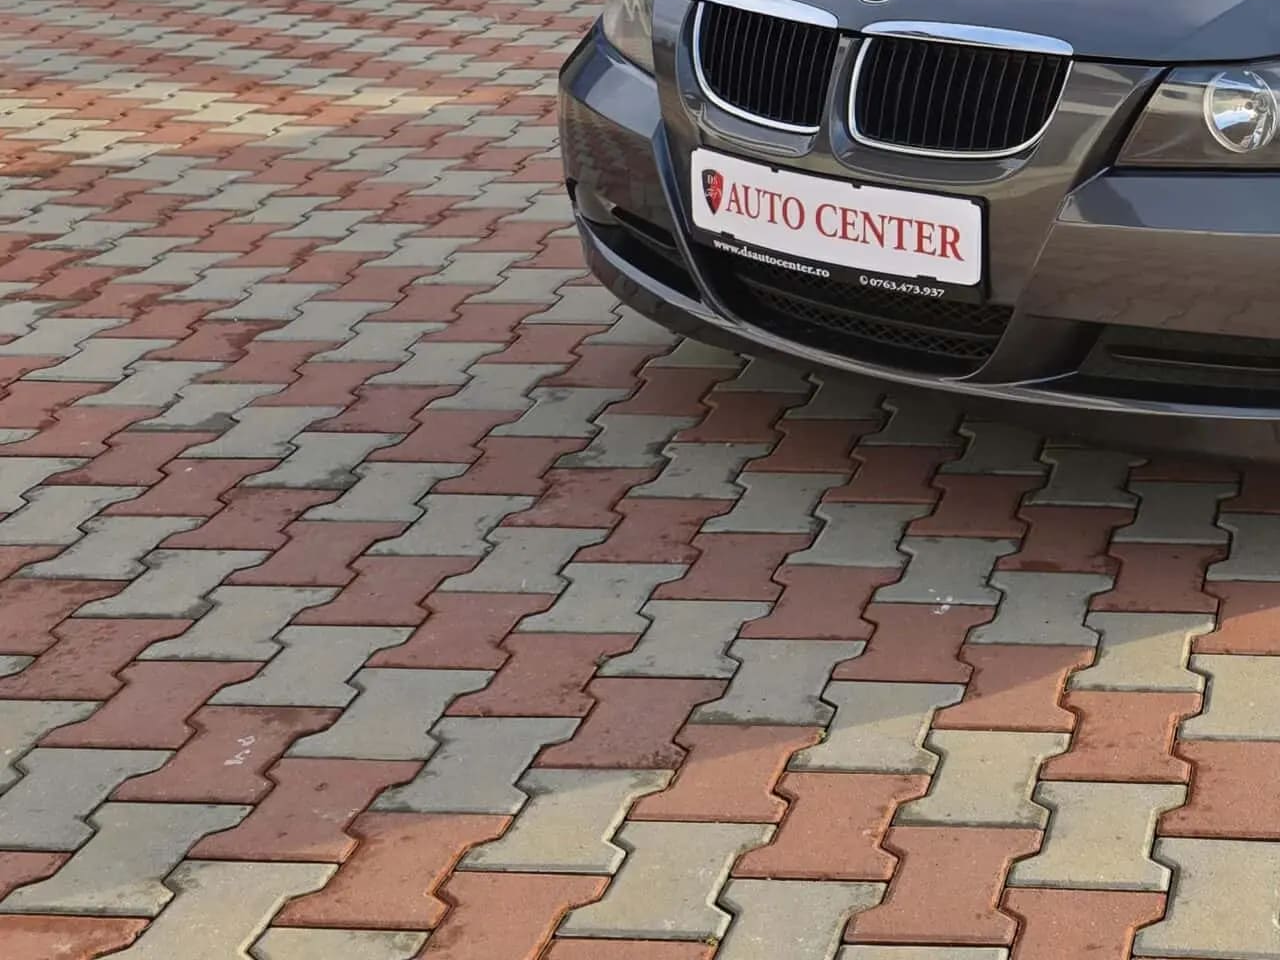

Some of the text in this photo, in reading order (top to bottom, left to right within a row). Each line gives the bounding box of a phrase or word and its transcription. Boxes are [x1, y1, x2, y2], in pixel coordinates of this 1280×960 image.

[725, 181, 965, 261] AUTO CENTER
[713, 240, 830, 278] www.dsautocenter.ro
[869, 278, 945, 297] 0763.473.937
